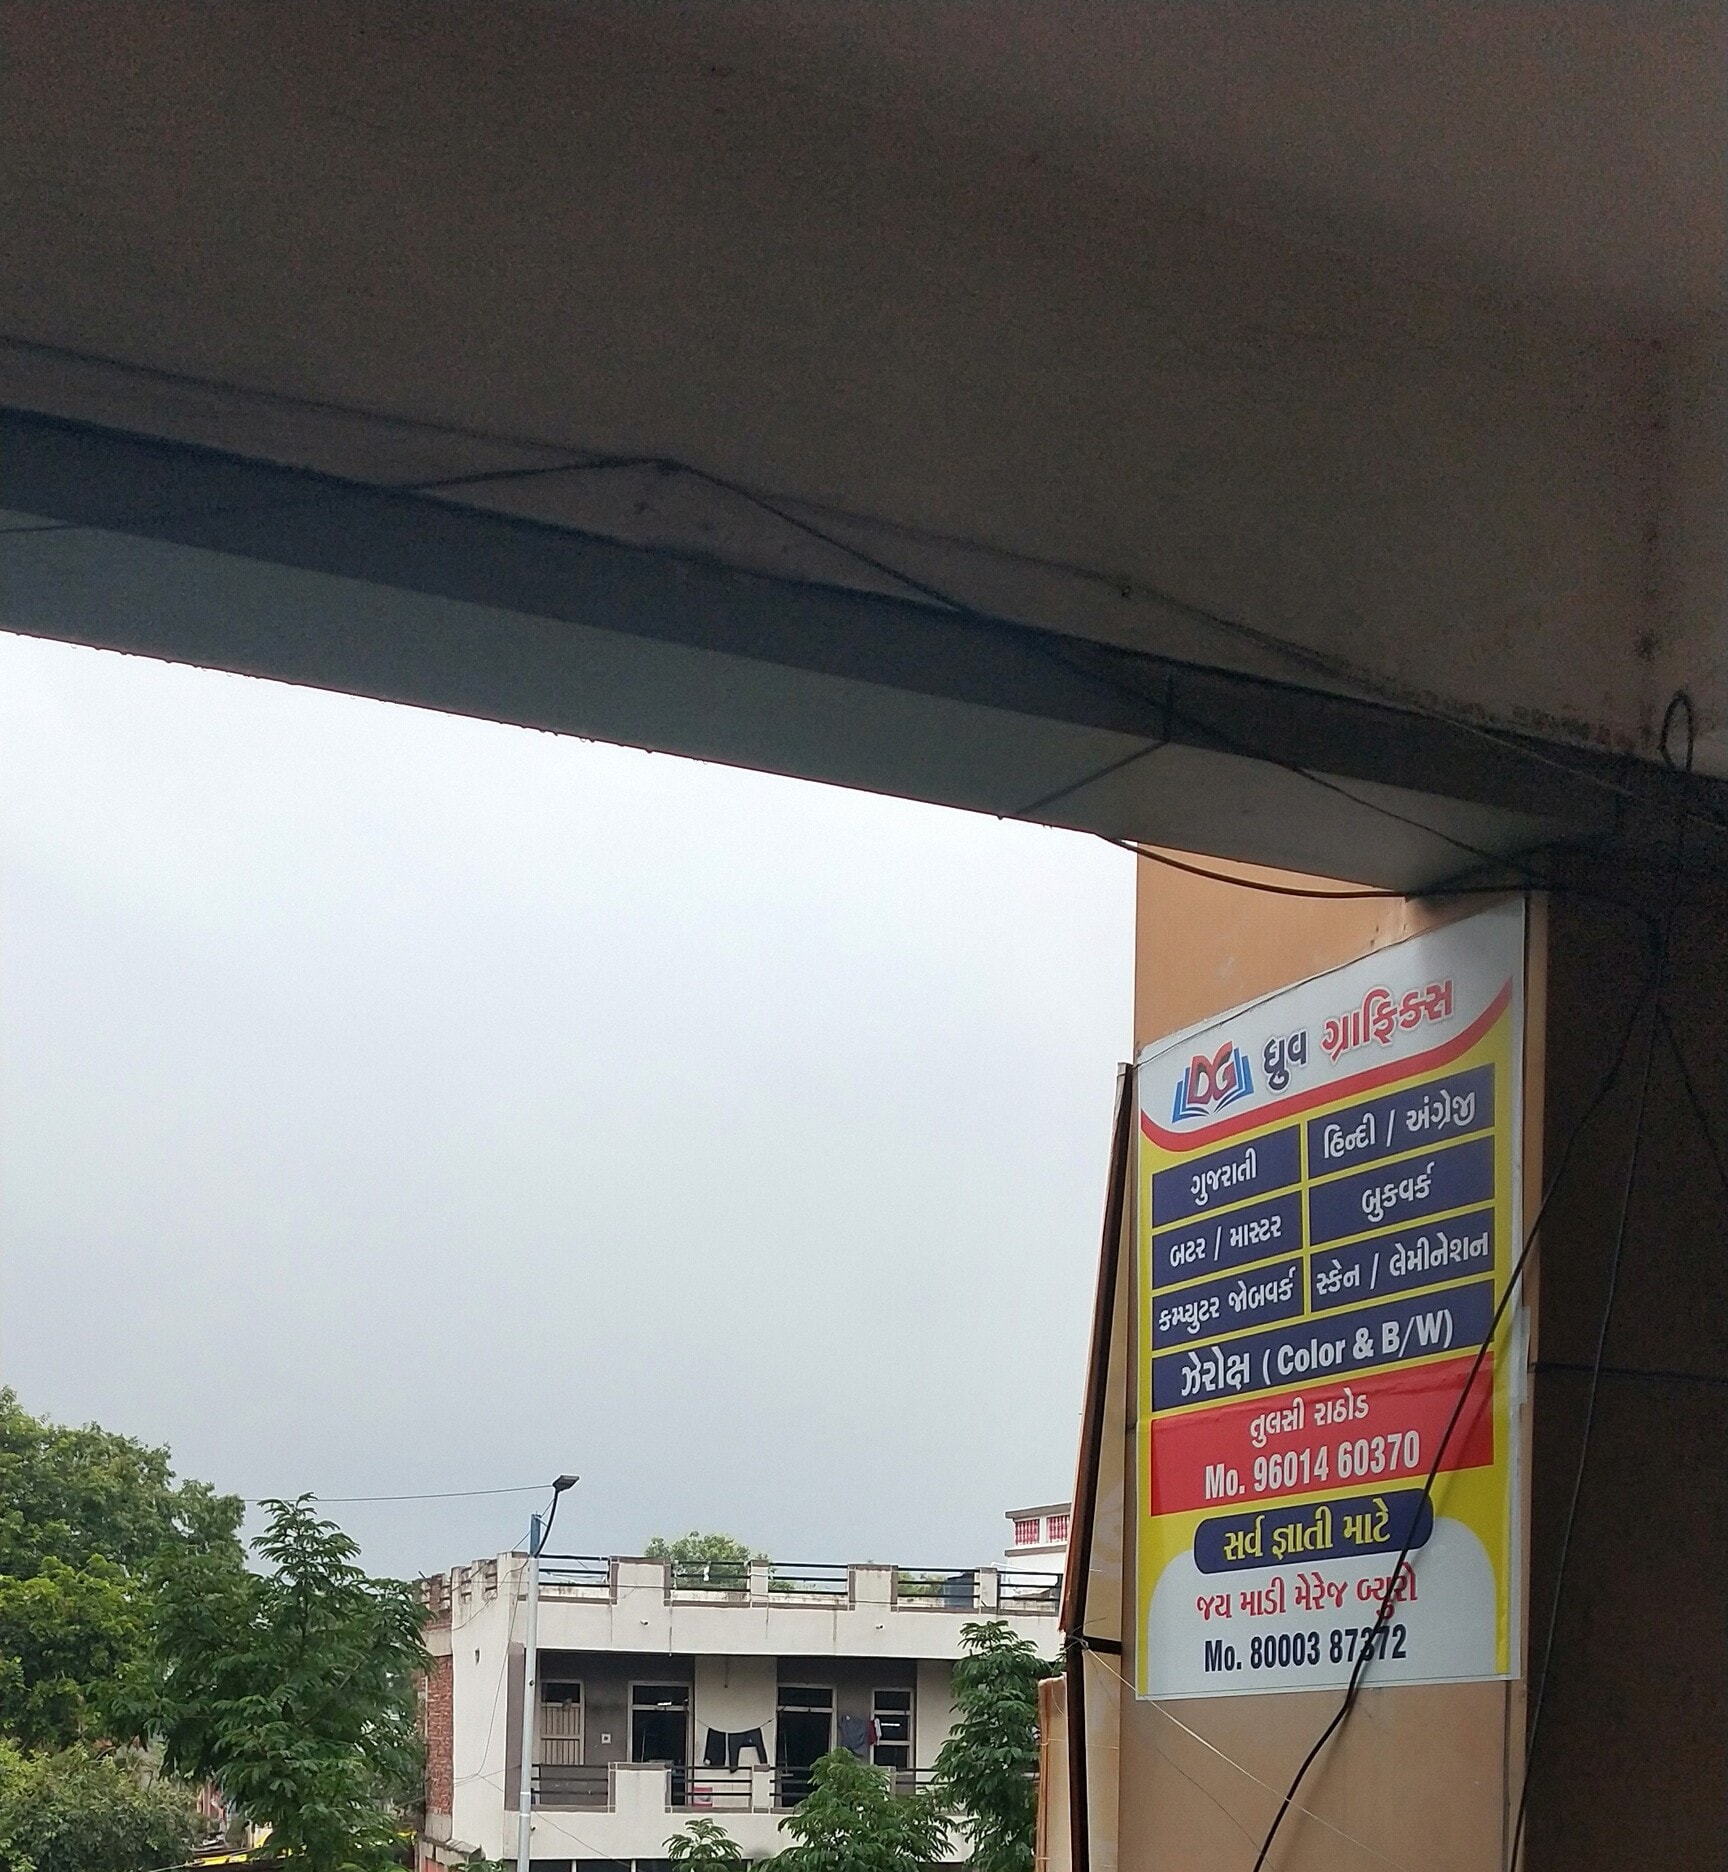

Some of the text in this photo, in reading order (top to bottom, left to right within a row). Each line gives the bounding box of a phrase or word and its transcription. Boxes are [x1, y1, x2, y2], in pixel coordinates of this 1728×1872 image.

[1322, 980, 1453, 1061] ગ્રાફિક્સ
[1324, 1112, 1376, 1158] હિન્દી
[1406, 1089, 1476, 1130] અંગ્રેજી
[1190, 1147, 1258, 1206] ગુજરાતી
[1361, 1161, 1435, 1223] બુકવર્ક
[1170, 1238, 1206, 1267] બટર
[1230, 1215, 1282, 1248] માસ્ટર
[1316, 1259, 1361, 1296] સ્કેન
[1389, 1231, 1490, 1277] લેમીનેશન
[1228, 1266, 1297, 1313] જોબવર્ક
[1181, 1346, 1250, 1397] ઝેરોક્ષ
[1277, 1338, 1346, 1377] Color
[1353, 1327, 1374, 1360] &
[1382, 1309, 1453, 1358] B/W)
[1250, 1387, 1370, 1448] તુલસી રાઠોડ
[1204, 1430, 1421, 1500] Mo. 96014 60370
[1223, 1498, 1390, 1561] સર્વ જ્ઞાતી માટે
[1196, 1593, 1231, 1621] જય
[1240, 1576, 1287, 1616] માડી
[1294, 1571, 1348, 1611] મેરેજ
[1204, 1623, 1407, 1673] Mo. 80003 87372
